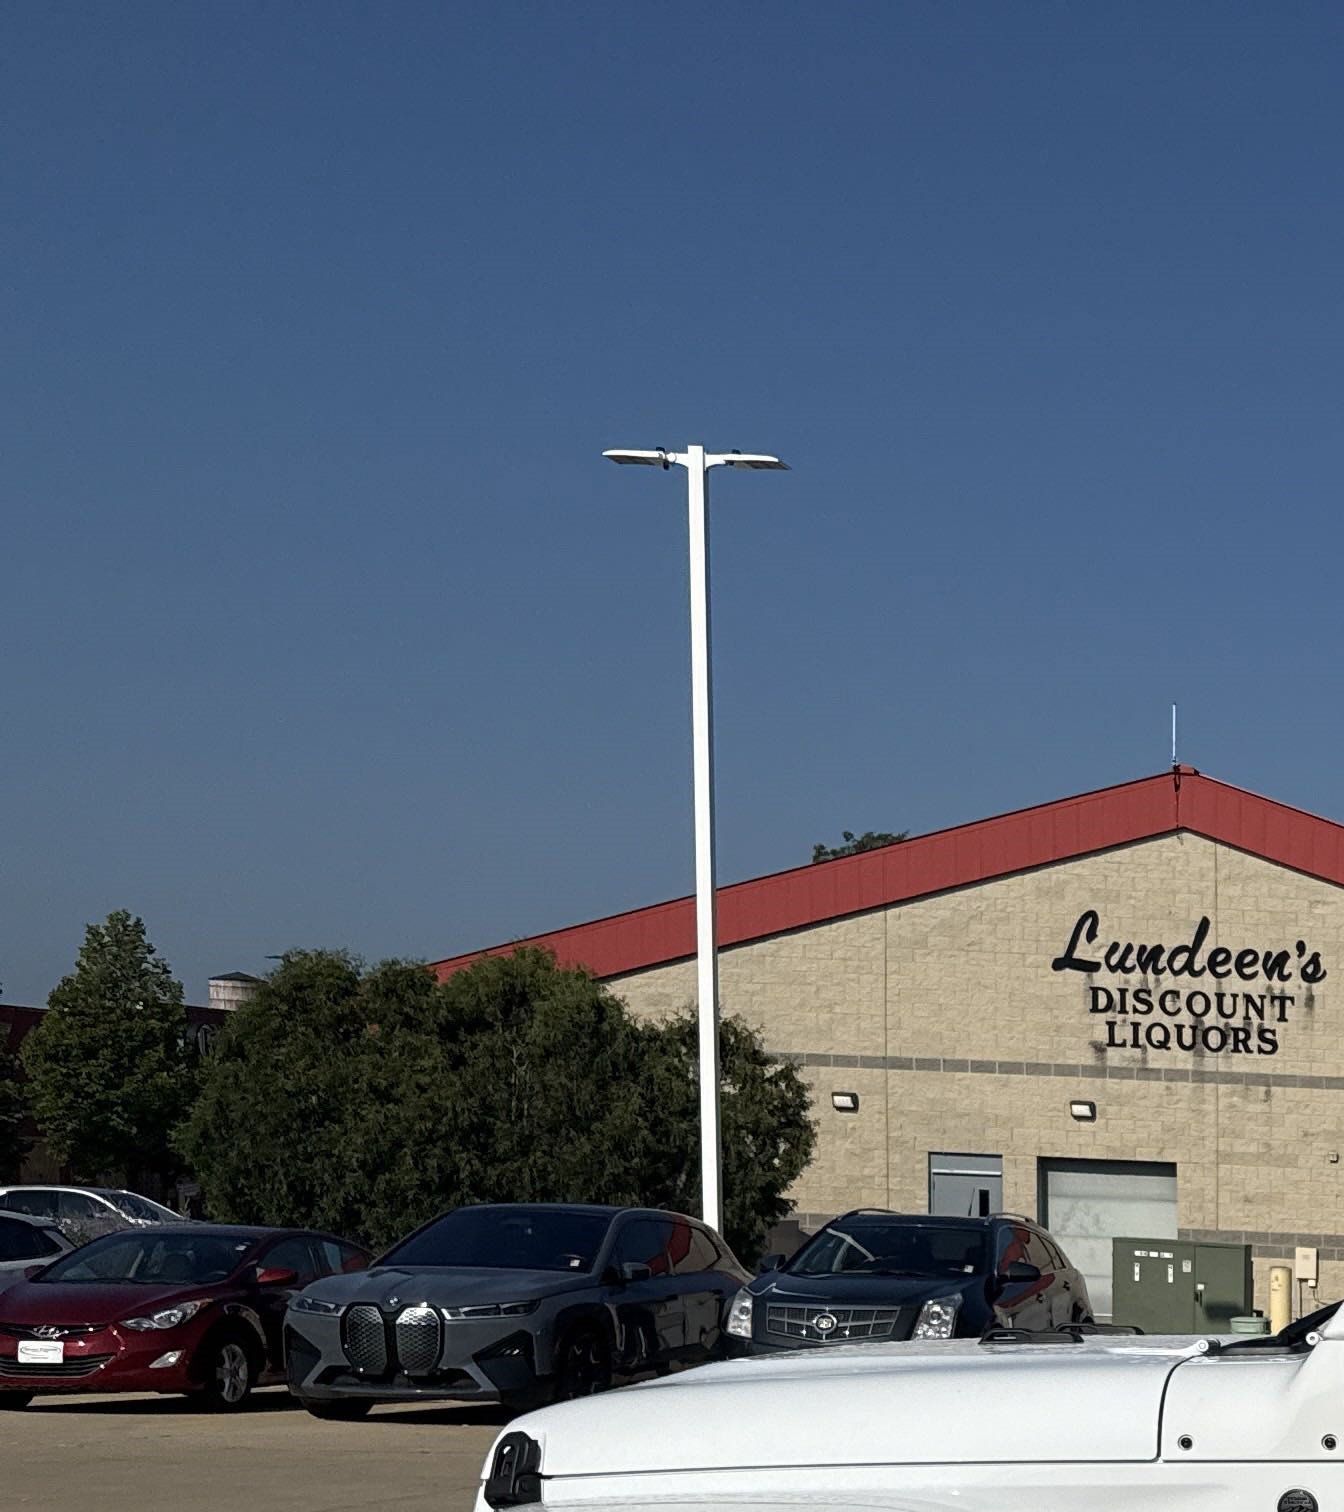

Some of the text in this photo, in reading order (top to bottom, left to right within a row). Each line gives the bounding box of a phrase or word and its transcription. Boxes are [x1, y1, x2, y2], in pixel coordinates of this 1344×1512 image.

[1051, 909, 1327, 983] Lundeen's
[1089, 986, 1295, 1022] DISCOUNT
[1105, 1021, 1279, 1055] LIQUORS
